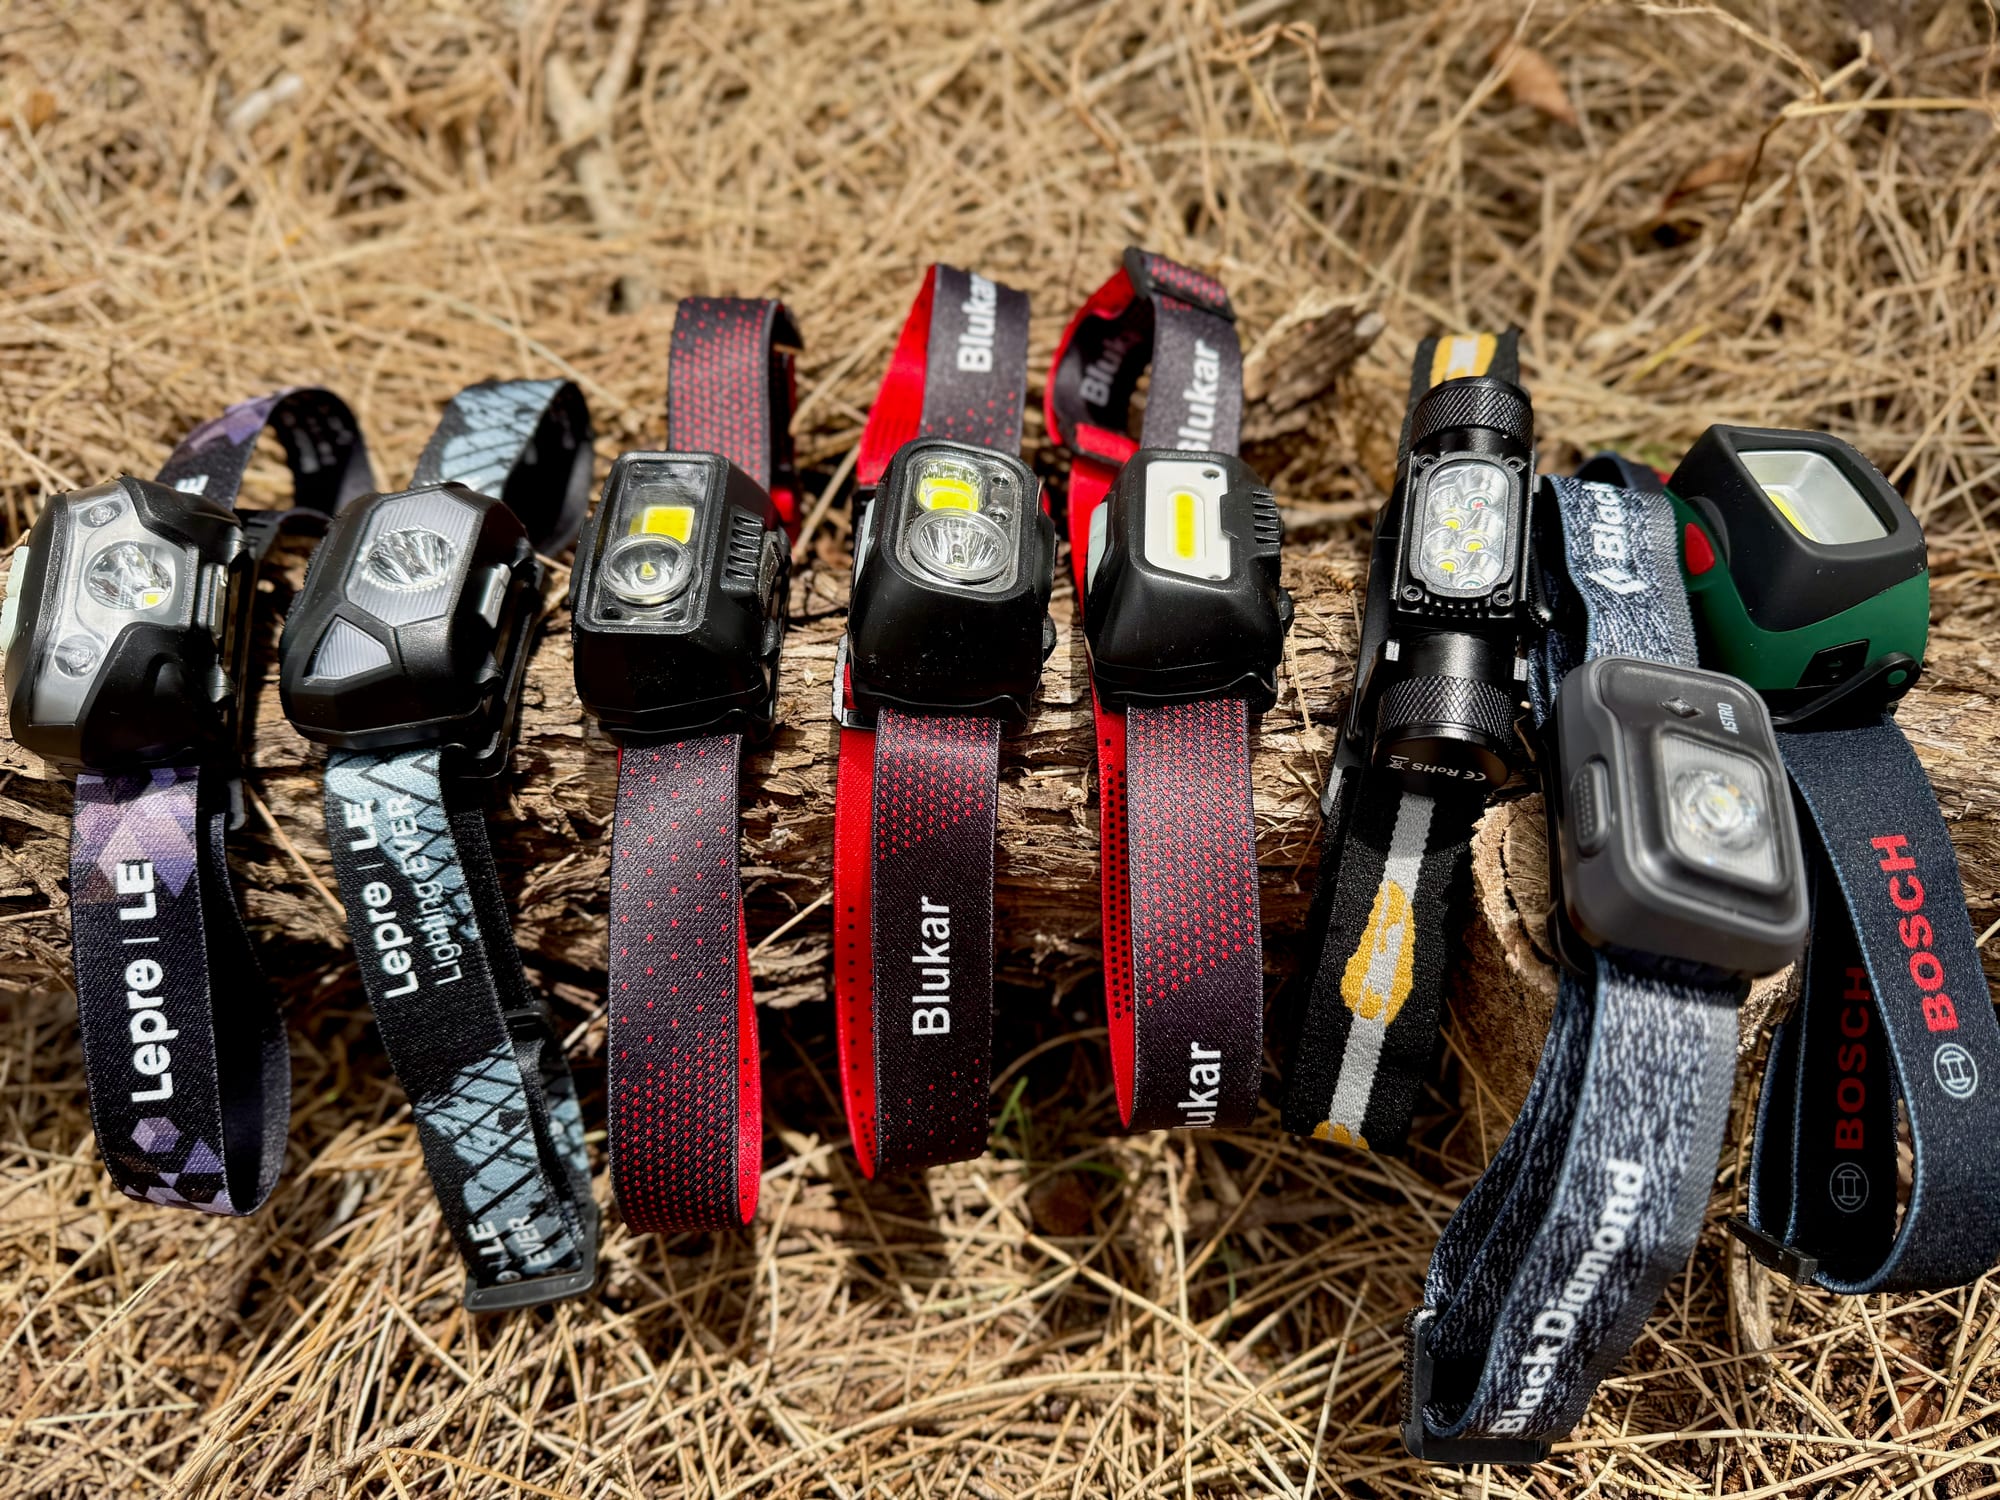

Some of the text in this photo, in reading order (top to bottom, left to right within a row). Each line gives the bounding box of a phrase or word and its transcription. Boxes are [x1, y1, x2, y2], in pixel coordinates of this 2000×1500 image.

[1411, 762, 1487, 781] CE RoHS
[1717, 702, 1740, 735] ASTRO
[344, 799, 420, 999] Lepre LE
[386, 794, 463, 986] Lighting EVER
[911, 895, 951, 1035] Blukar
[1870, 833, 1959, 1032] BOSCH
[116, 861, 180, 1102] Lepre LE
[1834, 967, 1871, 1150] BOSCH
[467, 1220, 507, 1255] LE
[507, 1214, 553, 1267] EVER
